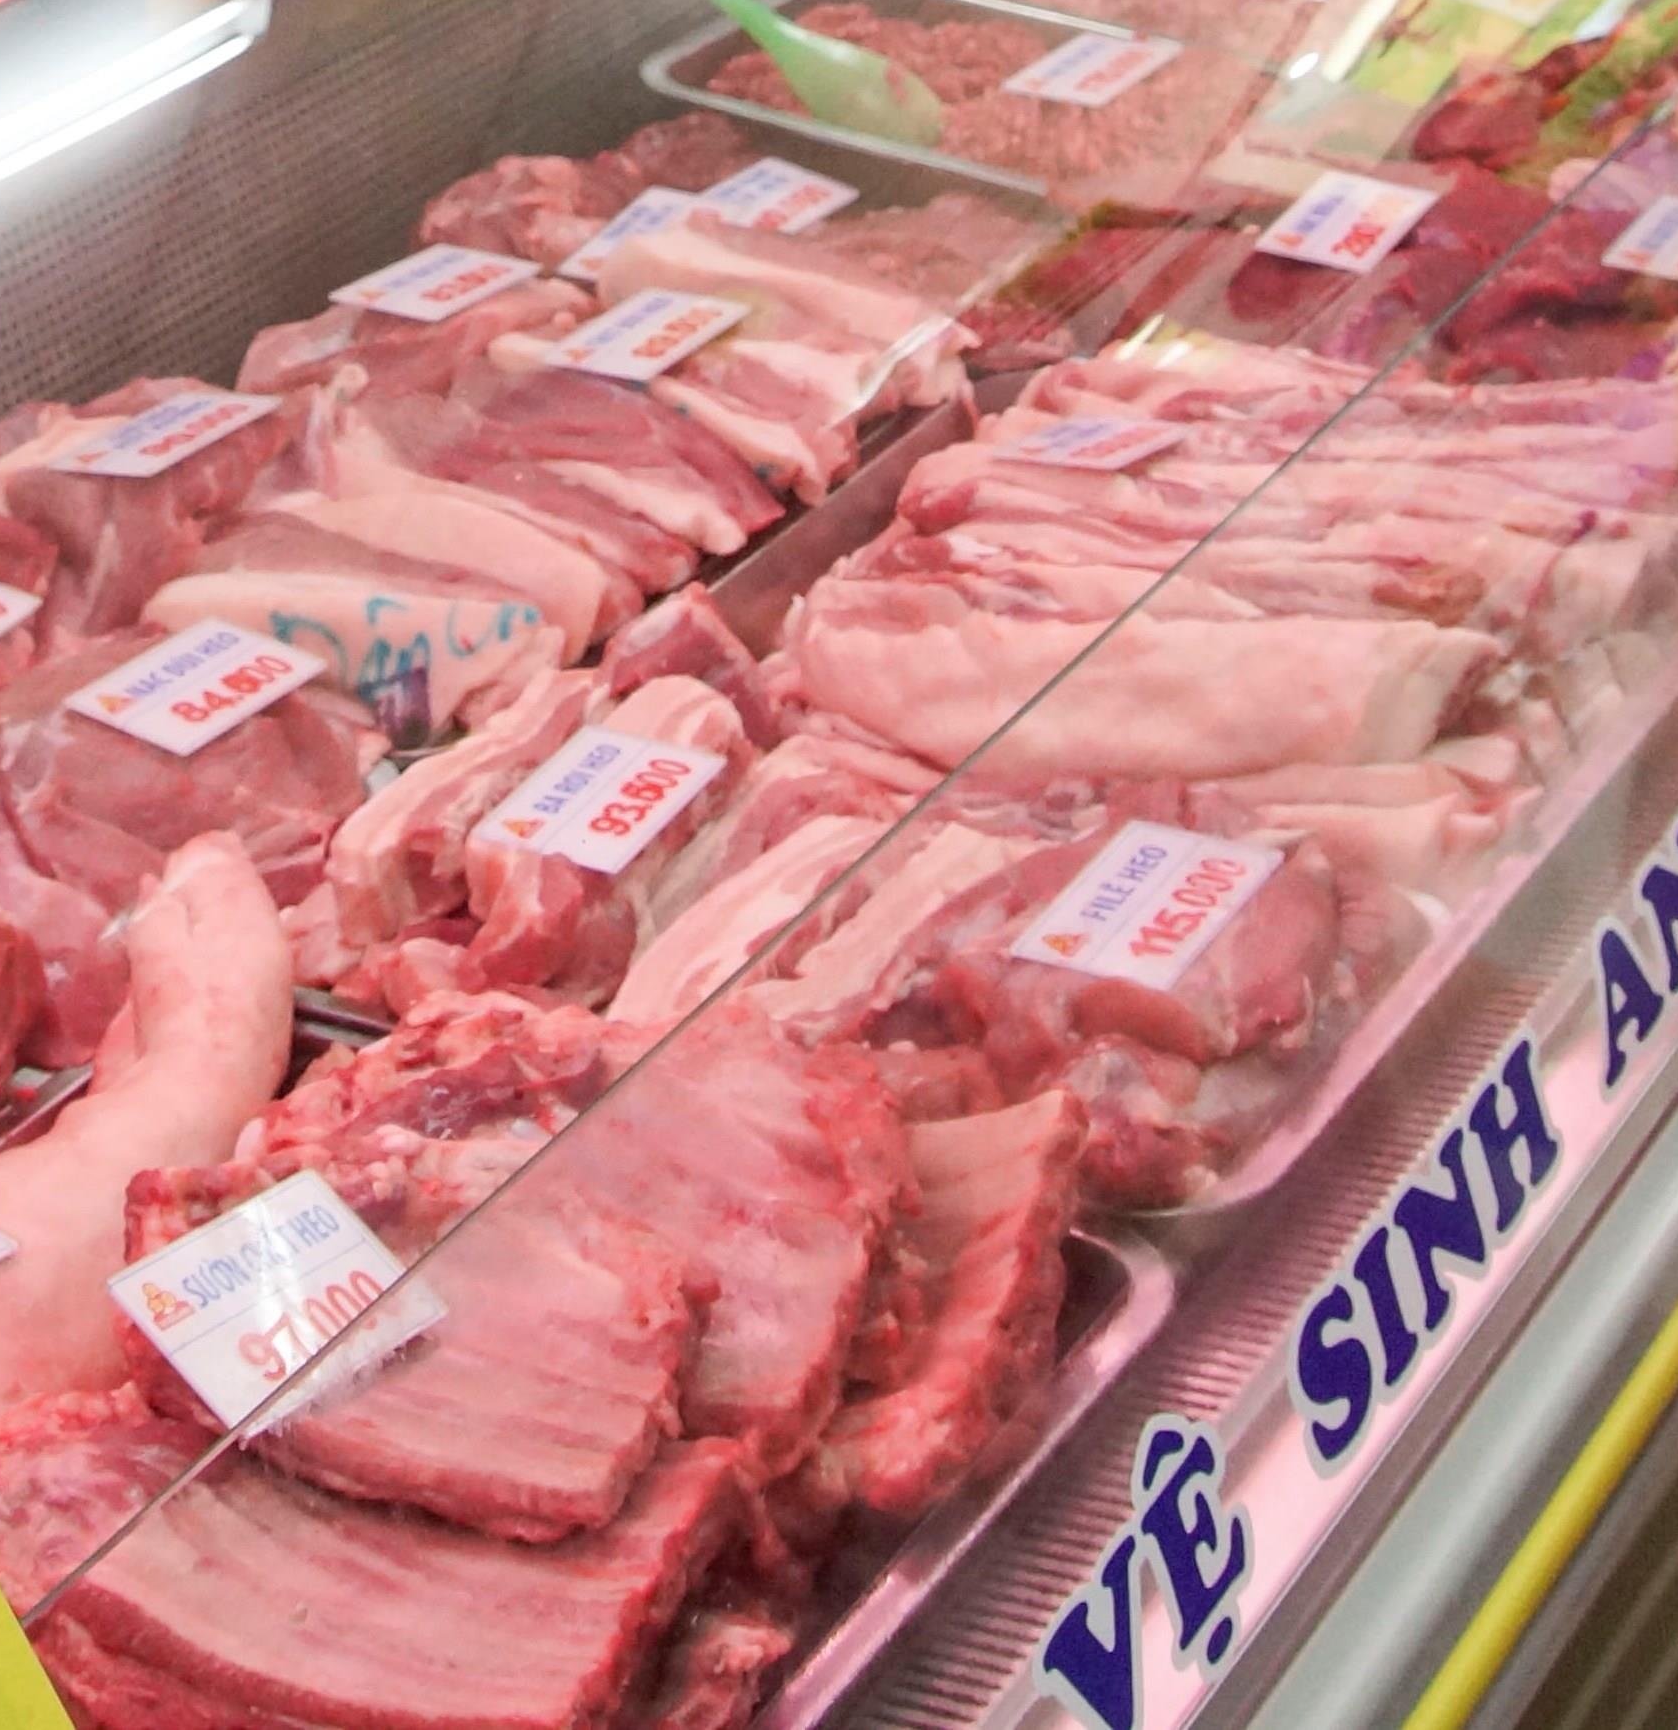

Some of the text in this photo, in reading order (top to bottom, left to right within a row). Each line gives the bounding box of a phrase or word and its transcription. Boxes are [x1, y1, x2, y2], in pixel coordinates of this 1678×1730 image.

[1122, 844, 1169, 883] HEO
[1128, 857, 1248, 959] 115.000
[295, 1204, 341, 1248] HEO
[1040, 1424, 1249, 1730] VỆ
[1293, 1039, 1564, 1467] SINH
